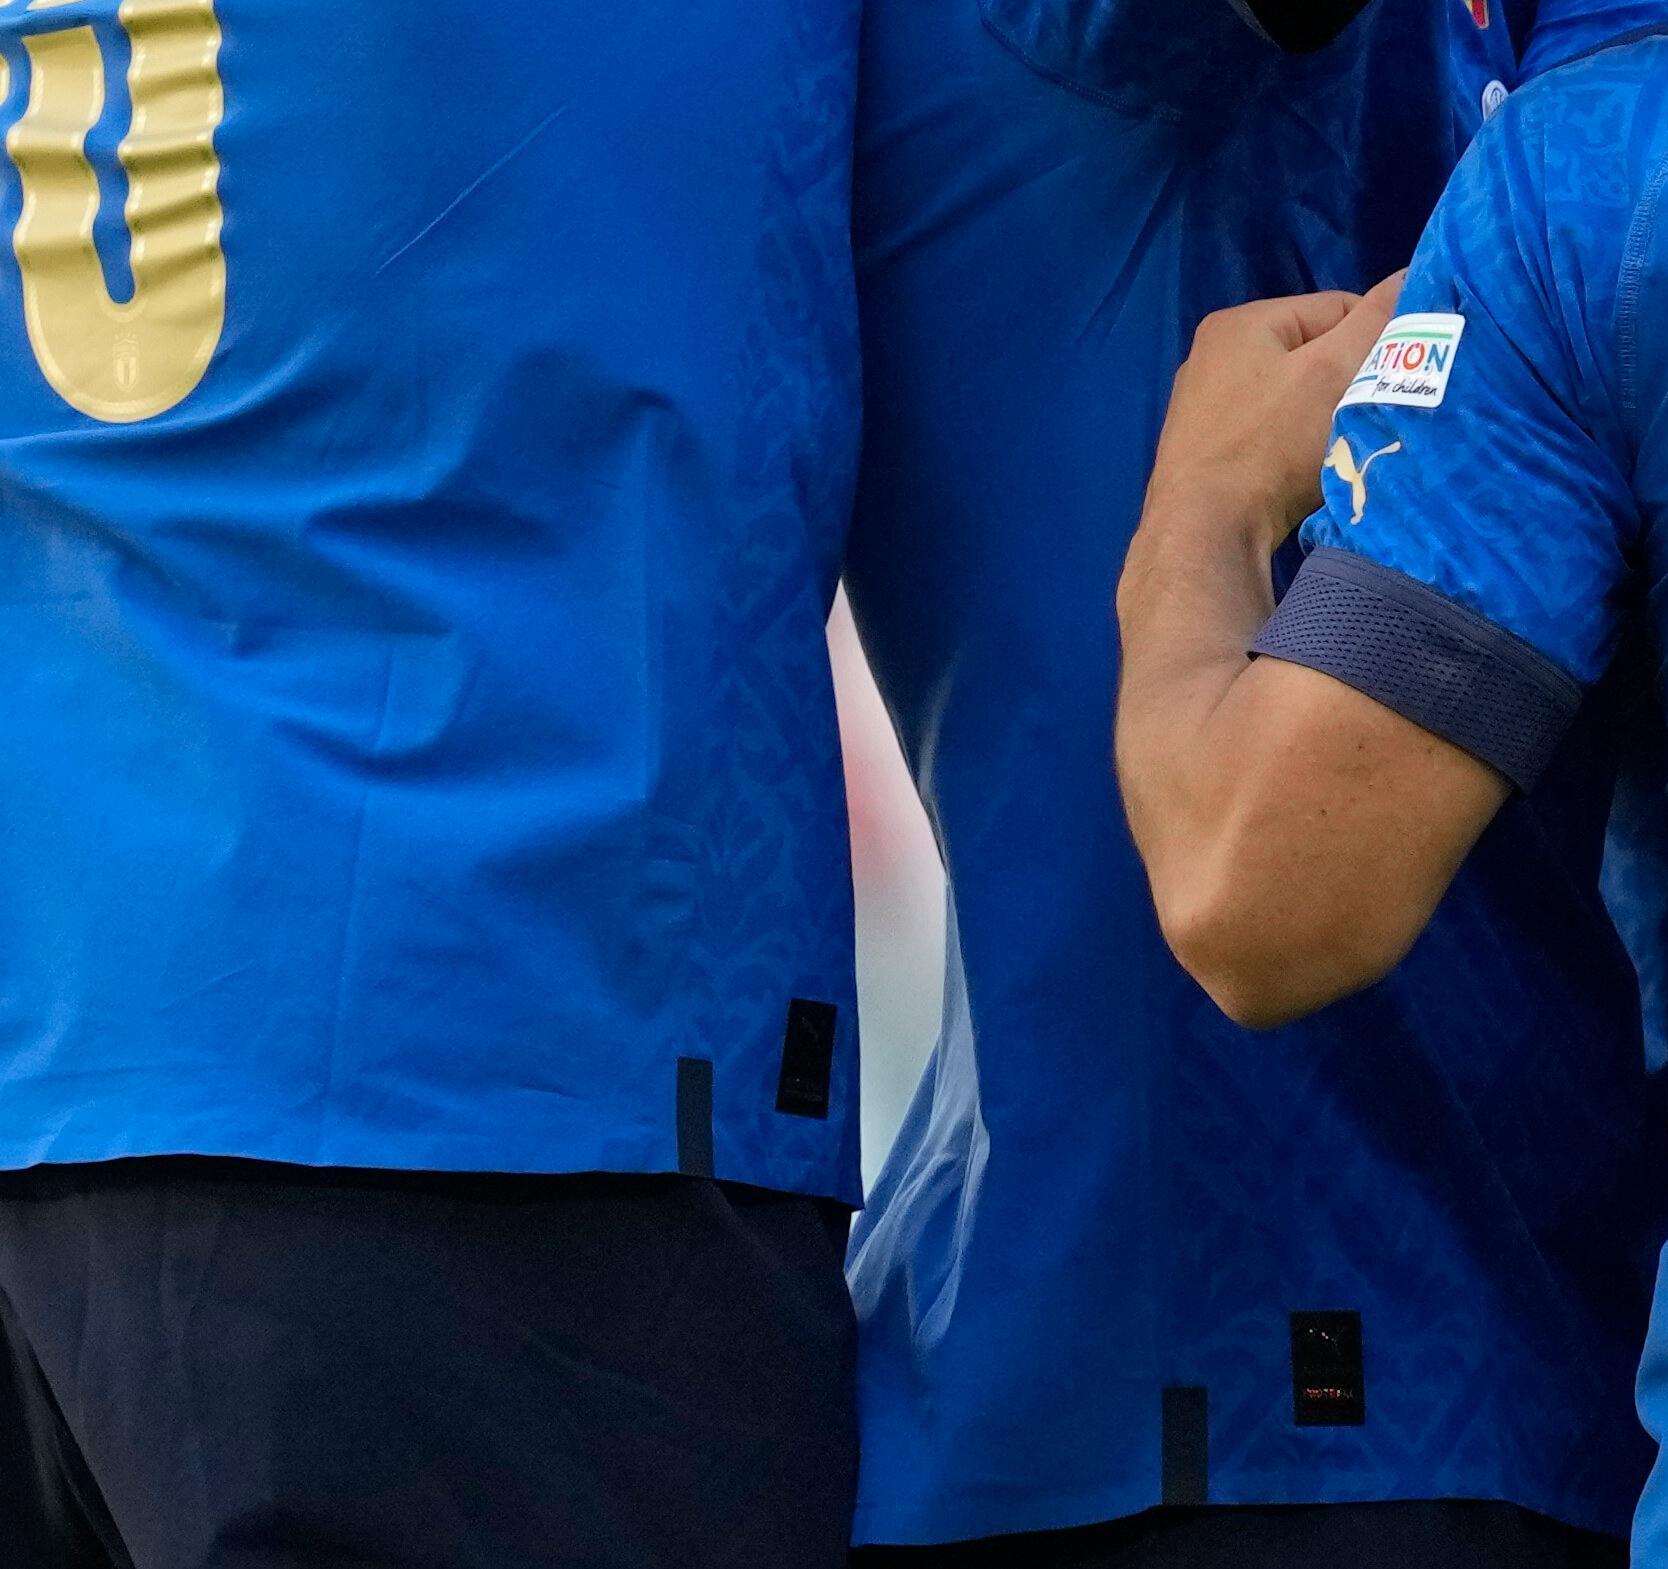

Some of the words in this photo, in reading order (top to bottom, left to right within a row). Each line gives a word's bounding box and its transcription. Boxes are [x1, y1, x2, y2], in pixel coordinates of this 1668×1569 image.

[1365, 341, 1450, 373] ATION
[1372, 376, 1390, 398] for
[1391, 378, 1438, 397] children
